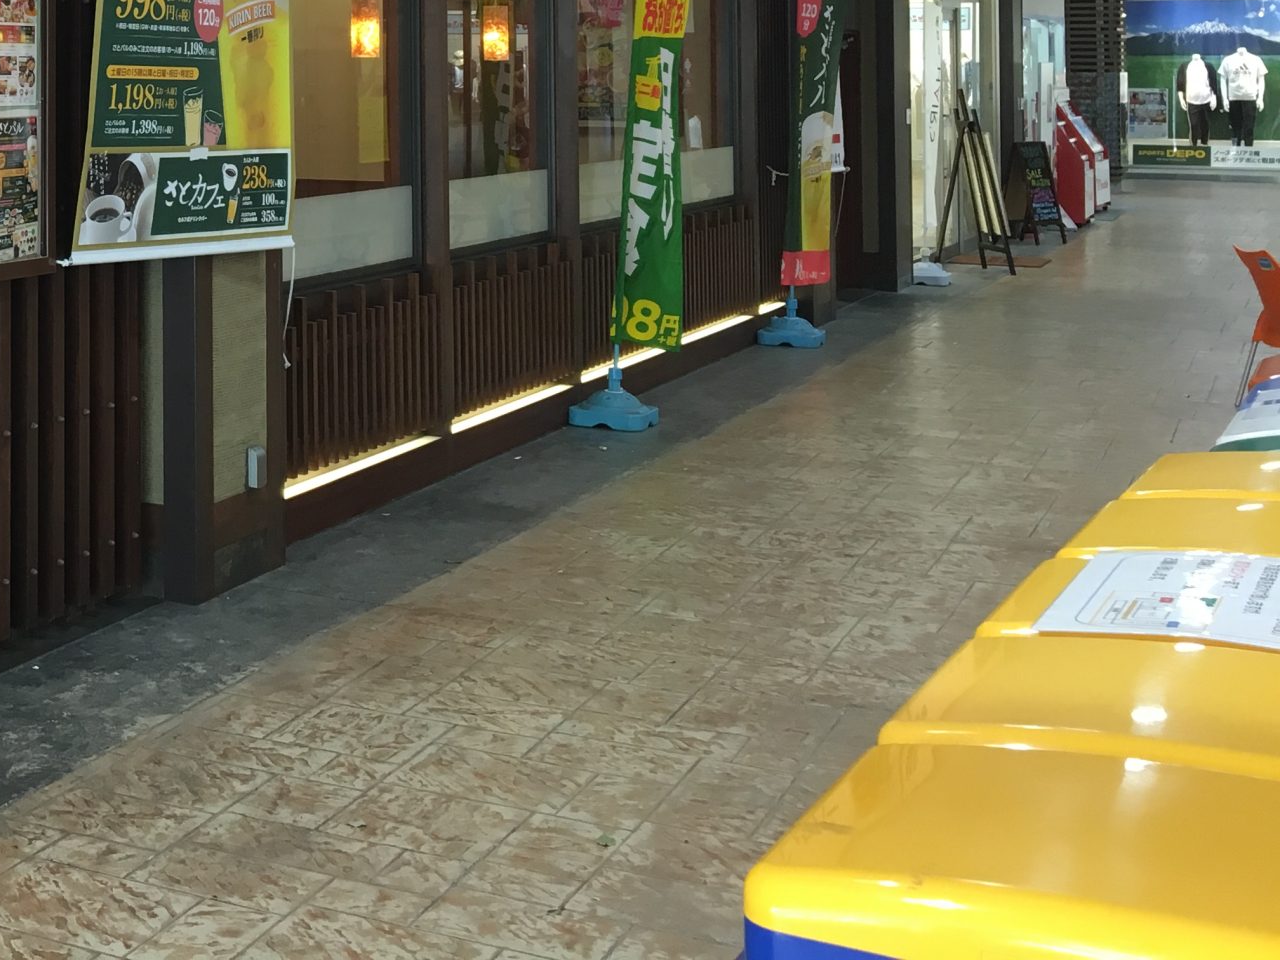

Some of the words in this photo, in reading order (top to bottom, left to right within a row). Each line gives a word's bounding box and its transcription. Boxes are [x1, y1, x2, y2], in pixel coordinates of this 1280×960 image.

[229, 7, 252, 28] KIRIN
[253, 3, 273, 19] BEER
[1166, 149, 1206, 158] DEPO
[1025, 168, 1042, 180] SALE
[163, 172, 226, 209] さとカフェ
